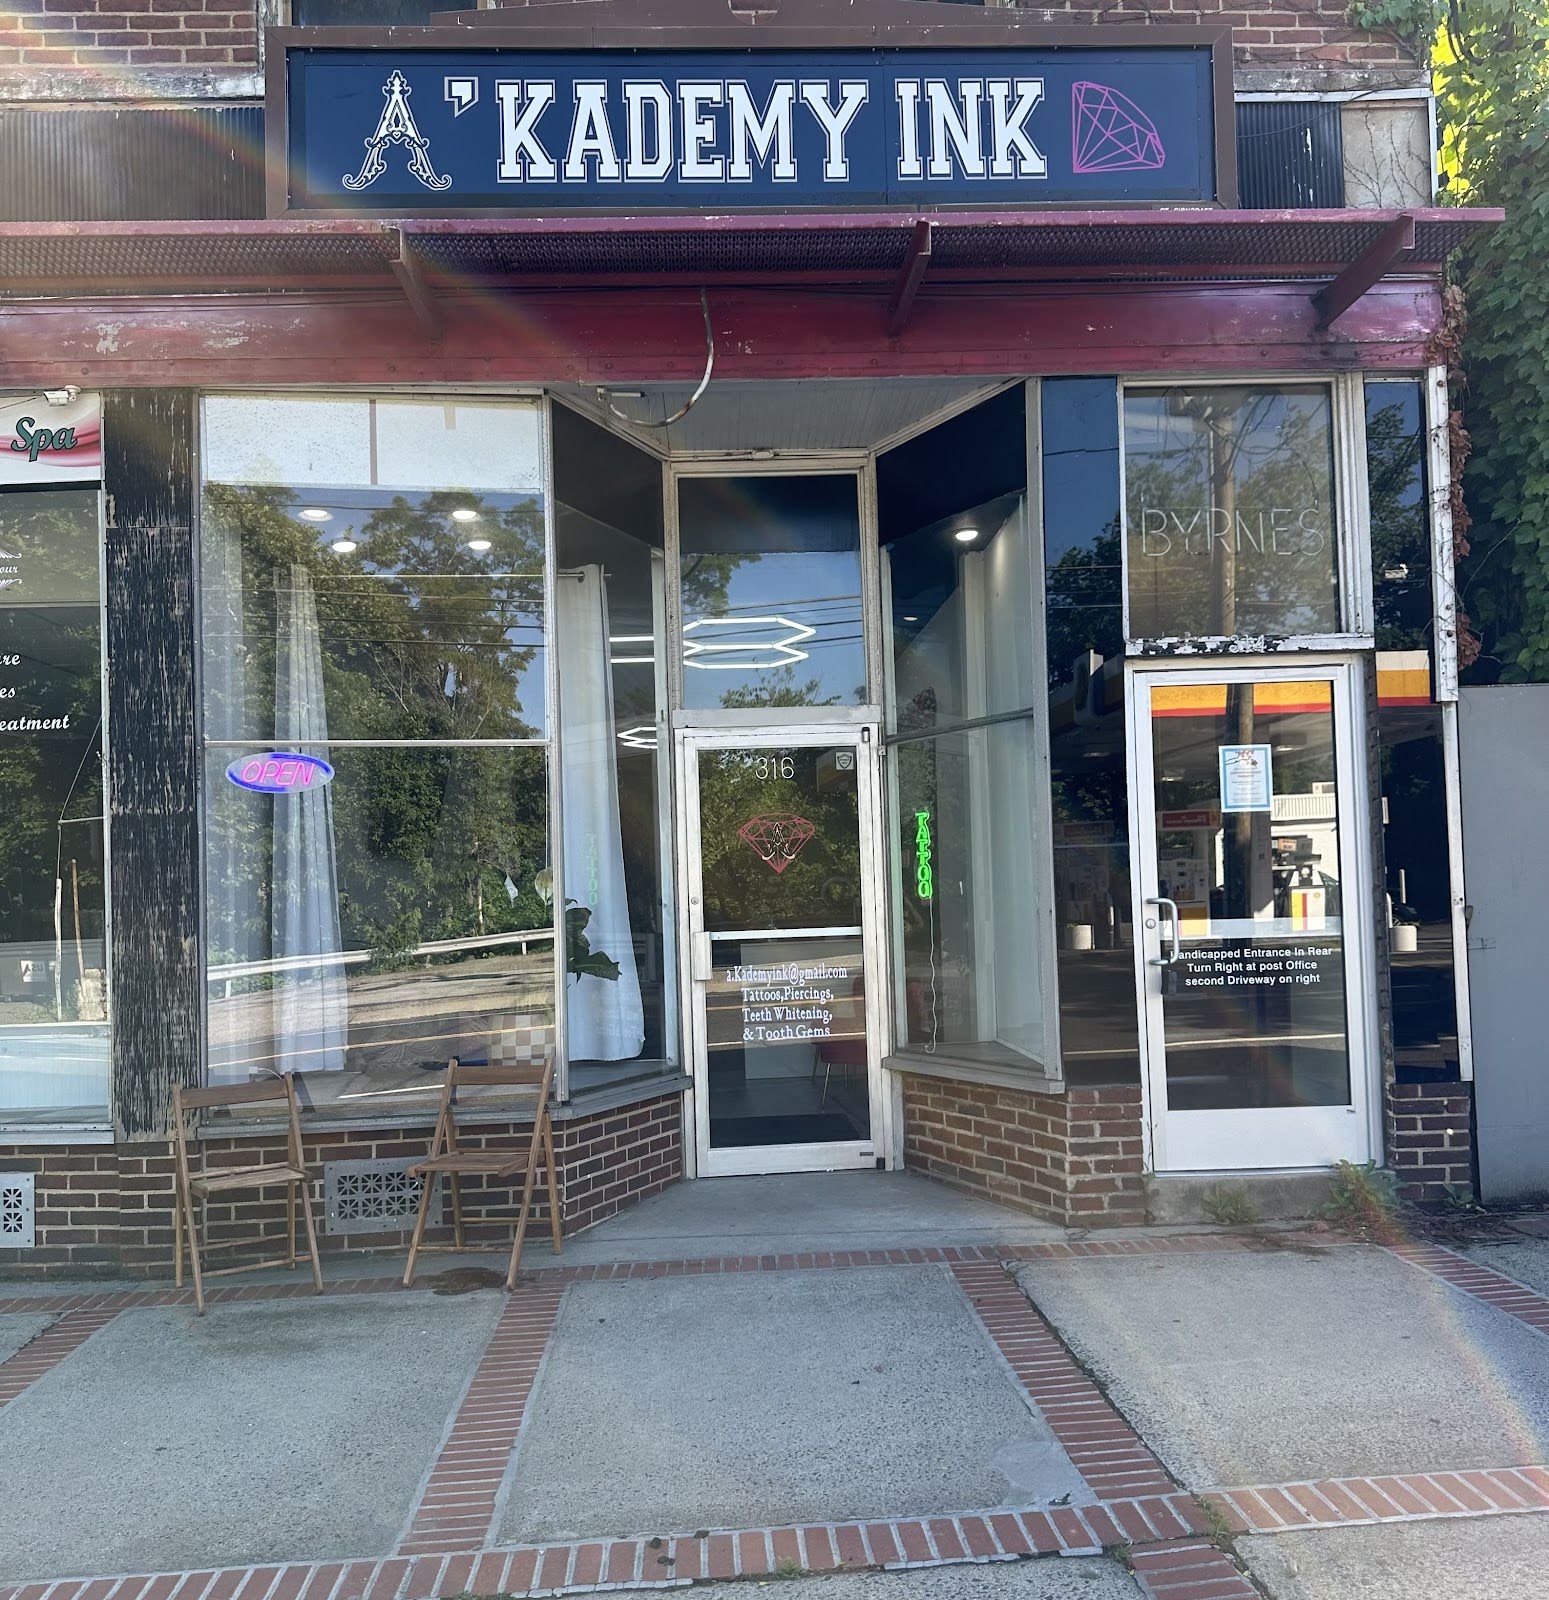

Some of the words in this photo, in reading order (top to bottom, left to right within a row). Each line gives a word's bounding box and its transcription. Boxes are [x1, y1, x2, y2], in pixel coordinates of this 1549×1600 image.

[895, 77, 1048, 180] INK
[11, 417, 78, 462] Spa
[1142, 508, 1325, 556] BYRNES
[242, 761, 316, 786] OPEN
[755, 757, 795, 780] 316
[915, 811, 933, 899] TATTOO
[1170, 948, 1241, 961] andicapped
[1244, 948, 1291, 958] Entrance
[1294, 946, 1305, 956] In
[1307, 946, 1332, 956] Rear
[726, 962, 848, 986] a.Kademyink@gmail.com
[1187, 963, 1212, 973] Turn
[1214, 962, 1243, 974] Right
[1246, 962, 1257, 971] at
[1259, 961, 1283, 973] post
[1285, 960, 1318, 970] Office
[1185, 975, 1225, 986] second
[1227, 975, 1276, 986] Driveway
[1278, 976, 1293, 984] on
[1295, 973, 1320, 985] right
[742, 1007, 772, 1022] Teeth
[773, 1006, 833, 1024] Whitening,
[742, 1027, 755, 1041] &
[756, 1025, 793, 1041] Tooth
[795, 1024, 831, 1038] Gems
